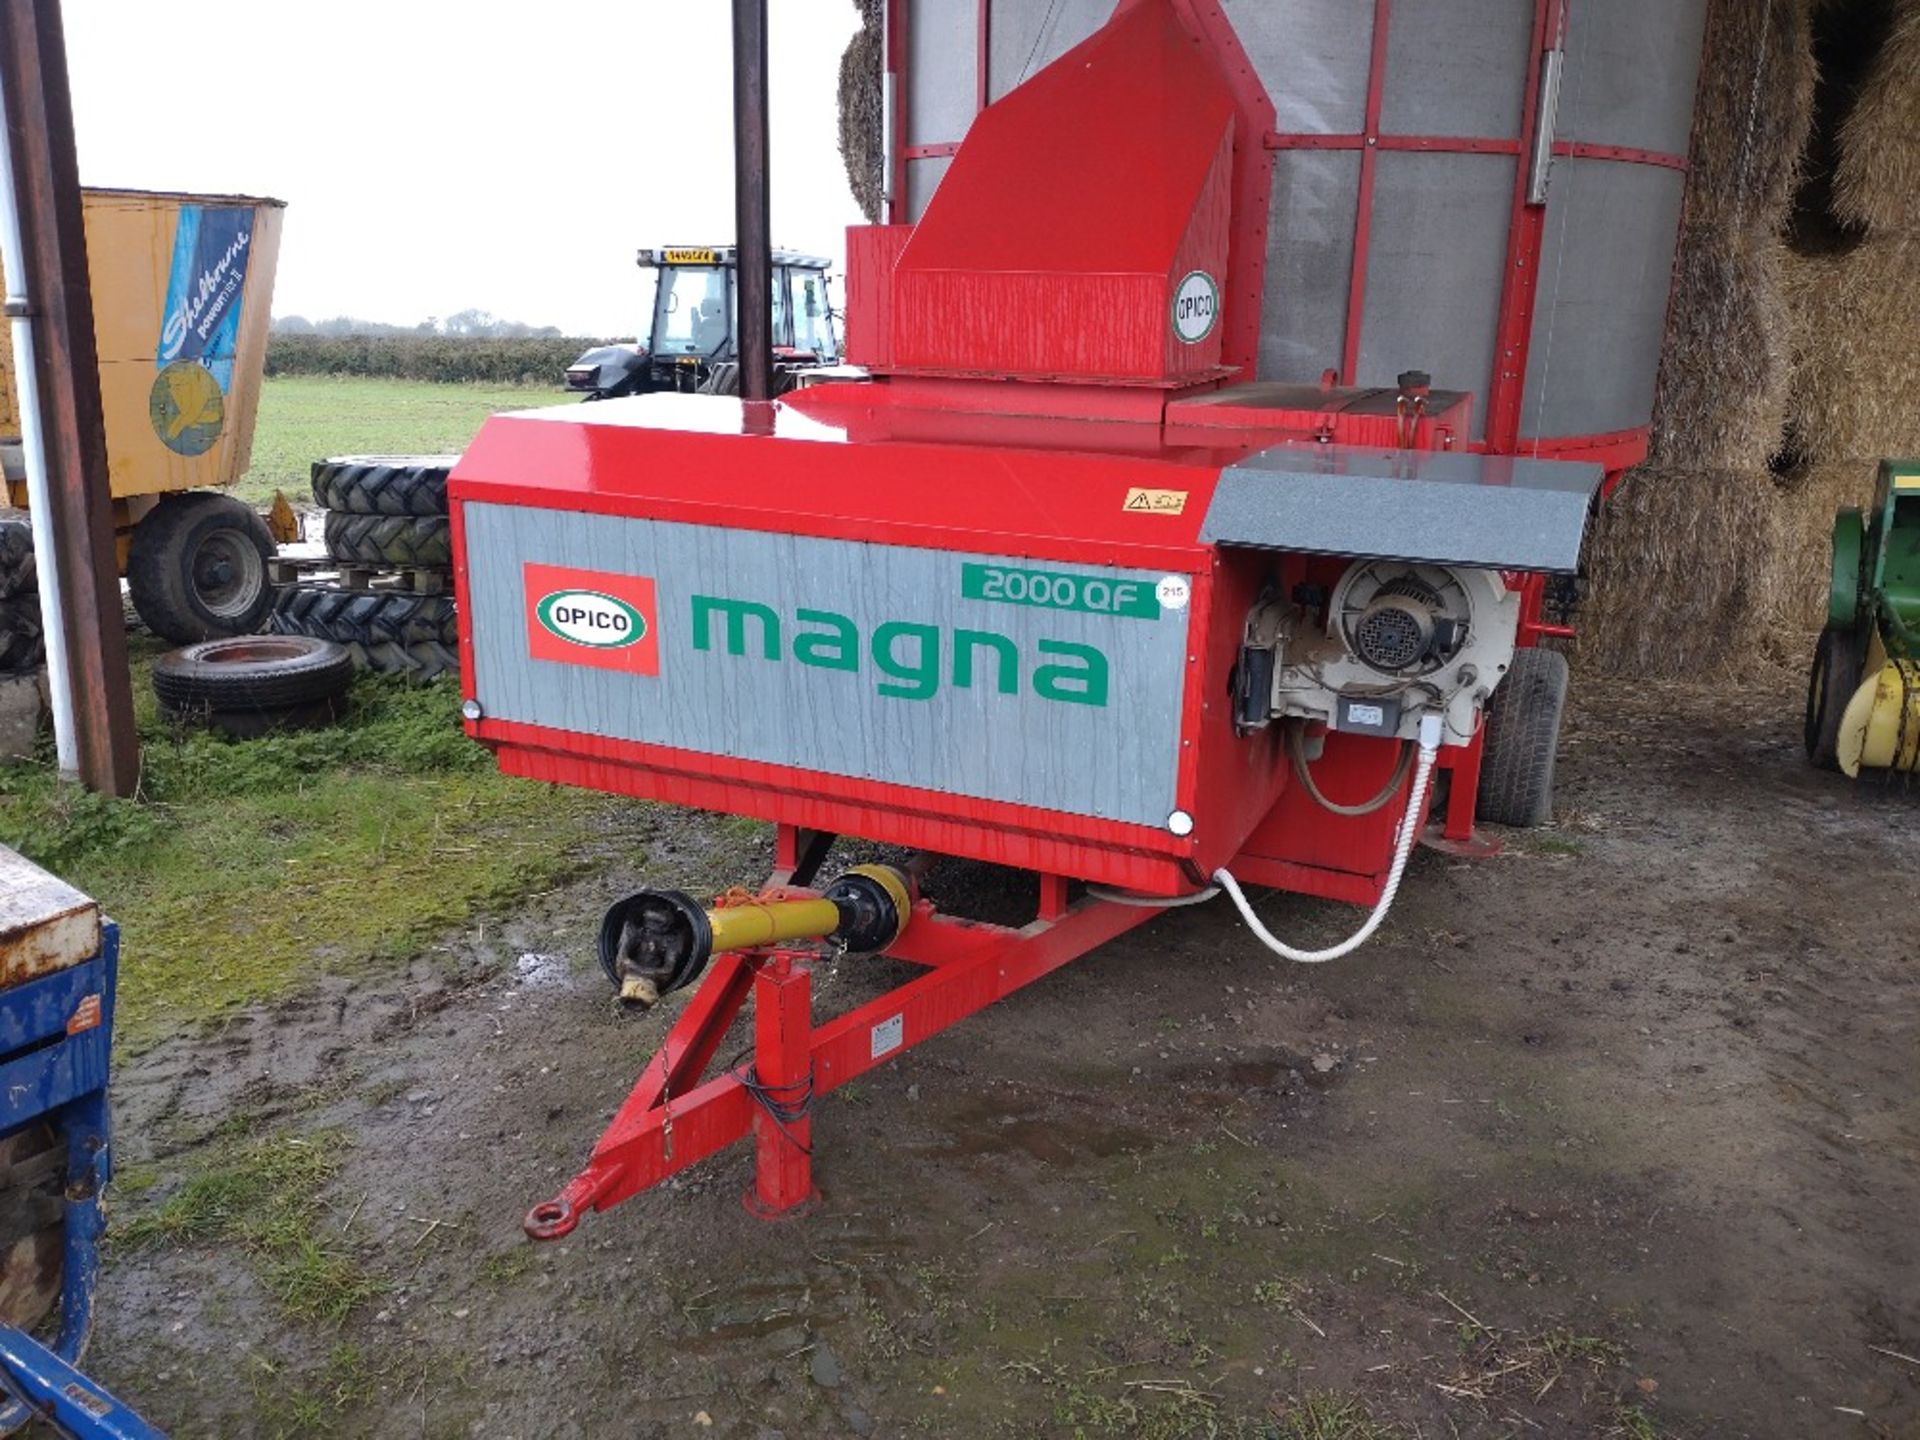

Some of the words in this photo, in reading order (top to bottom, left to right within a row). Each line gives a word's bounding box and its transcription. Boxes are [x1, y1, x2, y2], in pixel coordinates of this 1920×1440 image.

[162, 232, 249, 359] Shelbourne
[1178, 295, 1212, 319] OPICO
[983, 569, 1076, 606] 2000
[1083, 581, 1138, 611] QF
[1163, 586, 1184, 597] 215
[556, 606, 628, 632] OPICO
[691, 594, 1109, 707] magna
